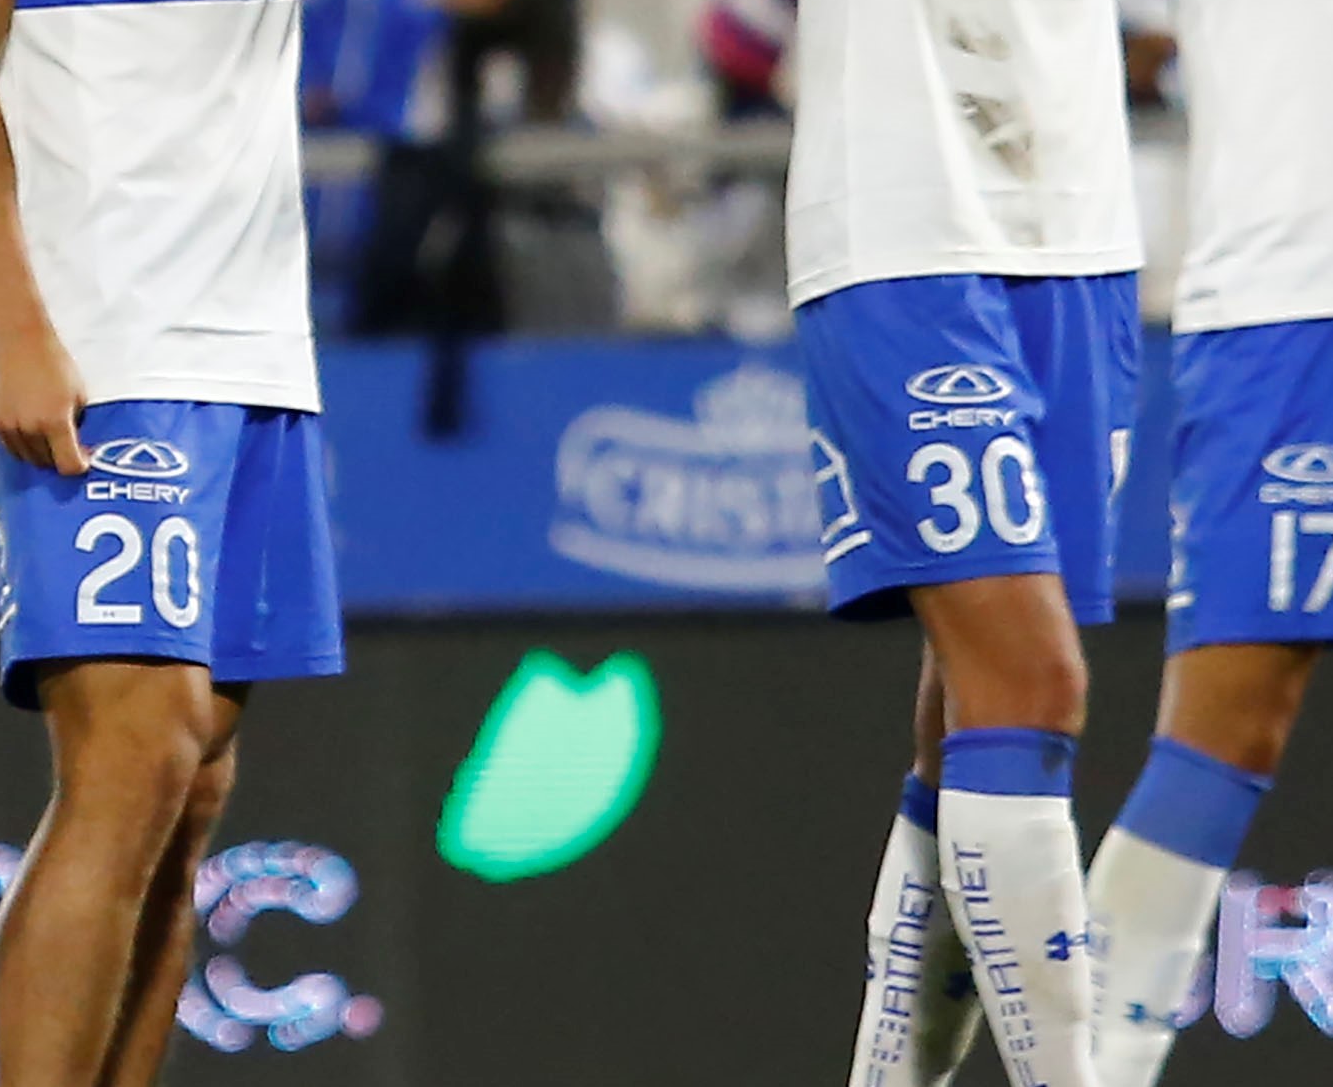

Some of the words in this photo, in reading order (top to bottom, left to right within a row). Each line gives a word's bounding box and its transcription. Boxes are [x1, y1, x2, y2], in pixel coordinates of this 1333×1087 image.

[909, 407, 1016, 431] CHERY
[87, 481, 189, 505] CHERY
[907, 435, 1045, 554] 30
[75, 513, 199, 628] 20
